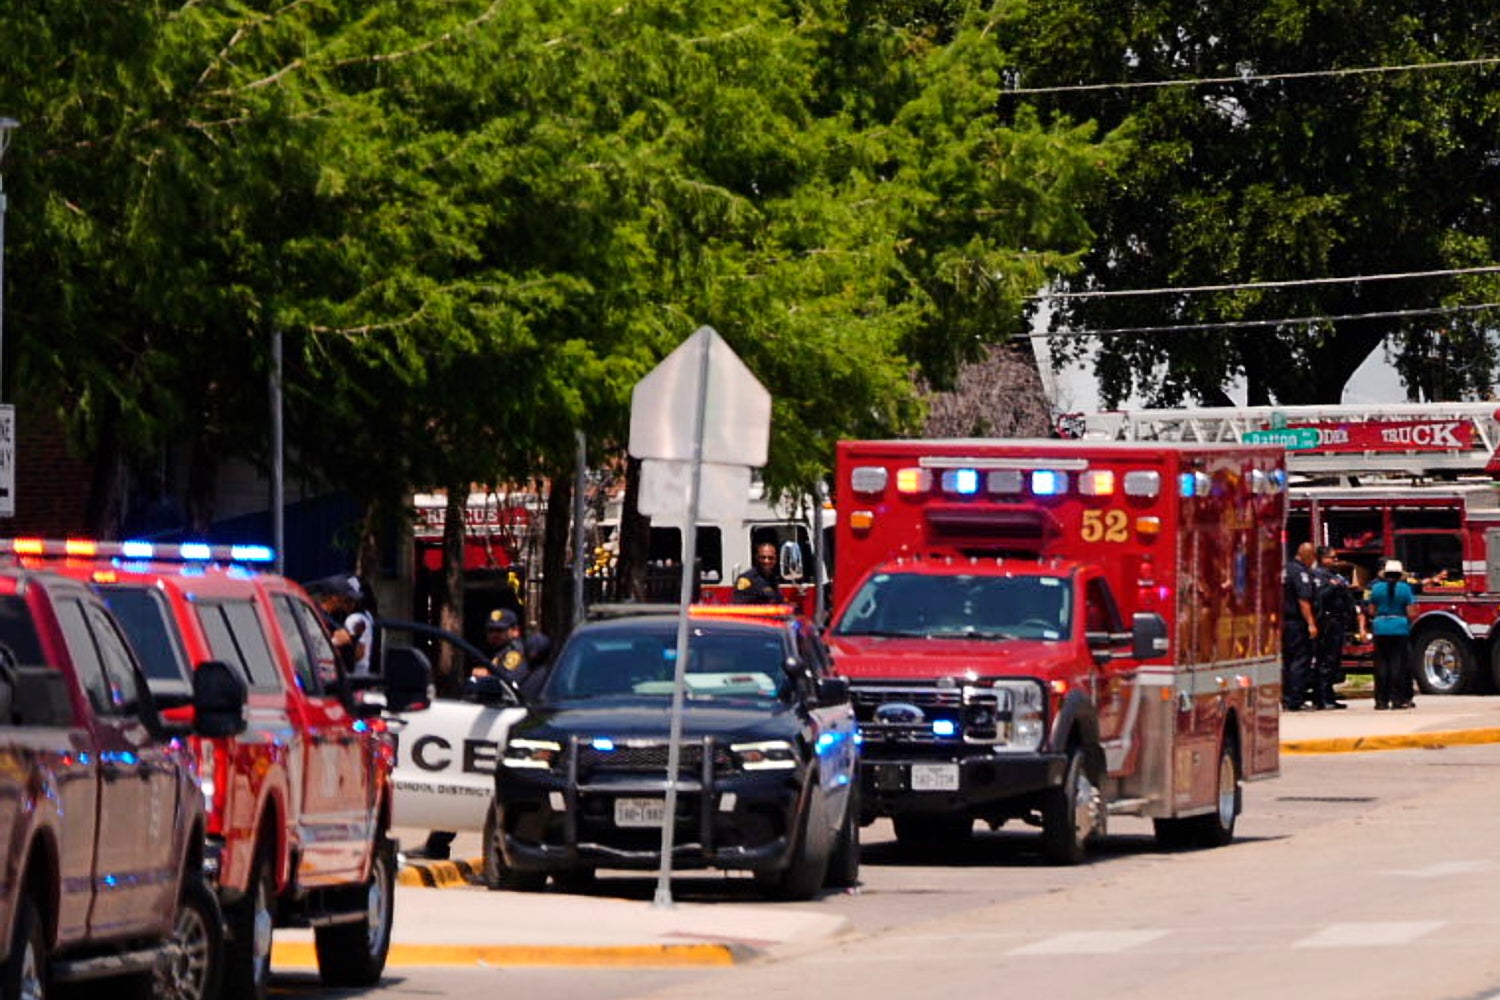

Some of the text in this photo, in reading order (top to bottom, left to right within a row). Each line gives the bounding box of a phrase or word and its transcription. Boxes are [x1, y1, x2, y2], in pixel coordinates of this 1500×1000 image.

[1381, 422, 1463, 447] TRUCK
[1081, 510, 1128, 542] 52
[437, 785, 490, 798] DISTRICT
